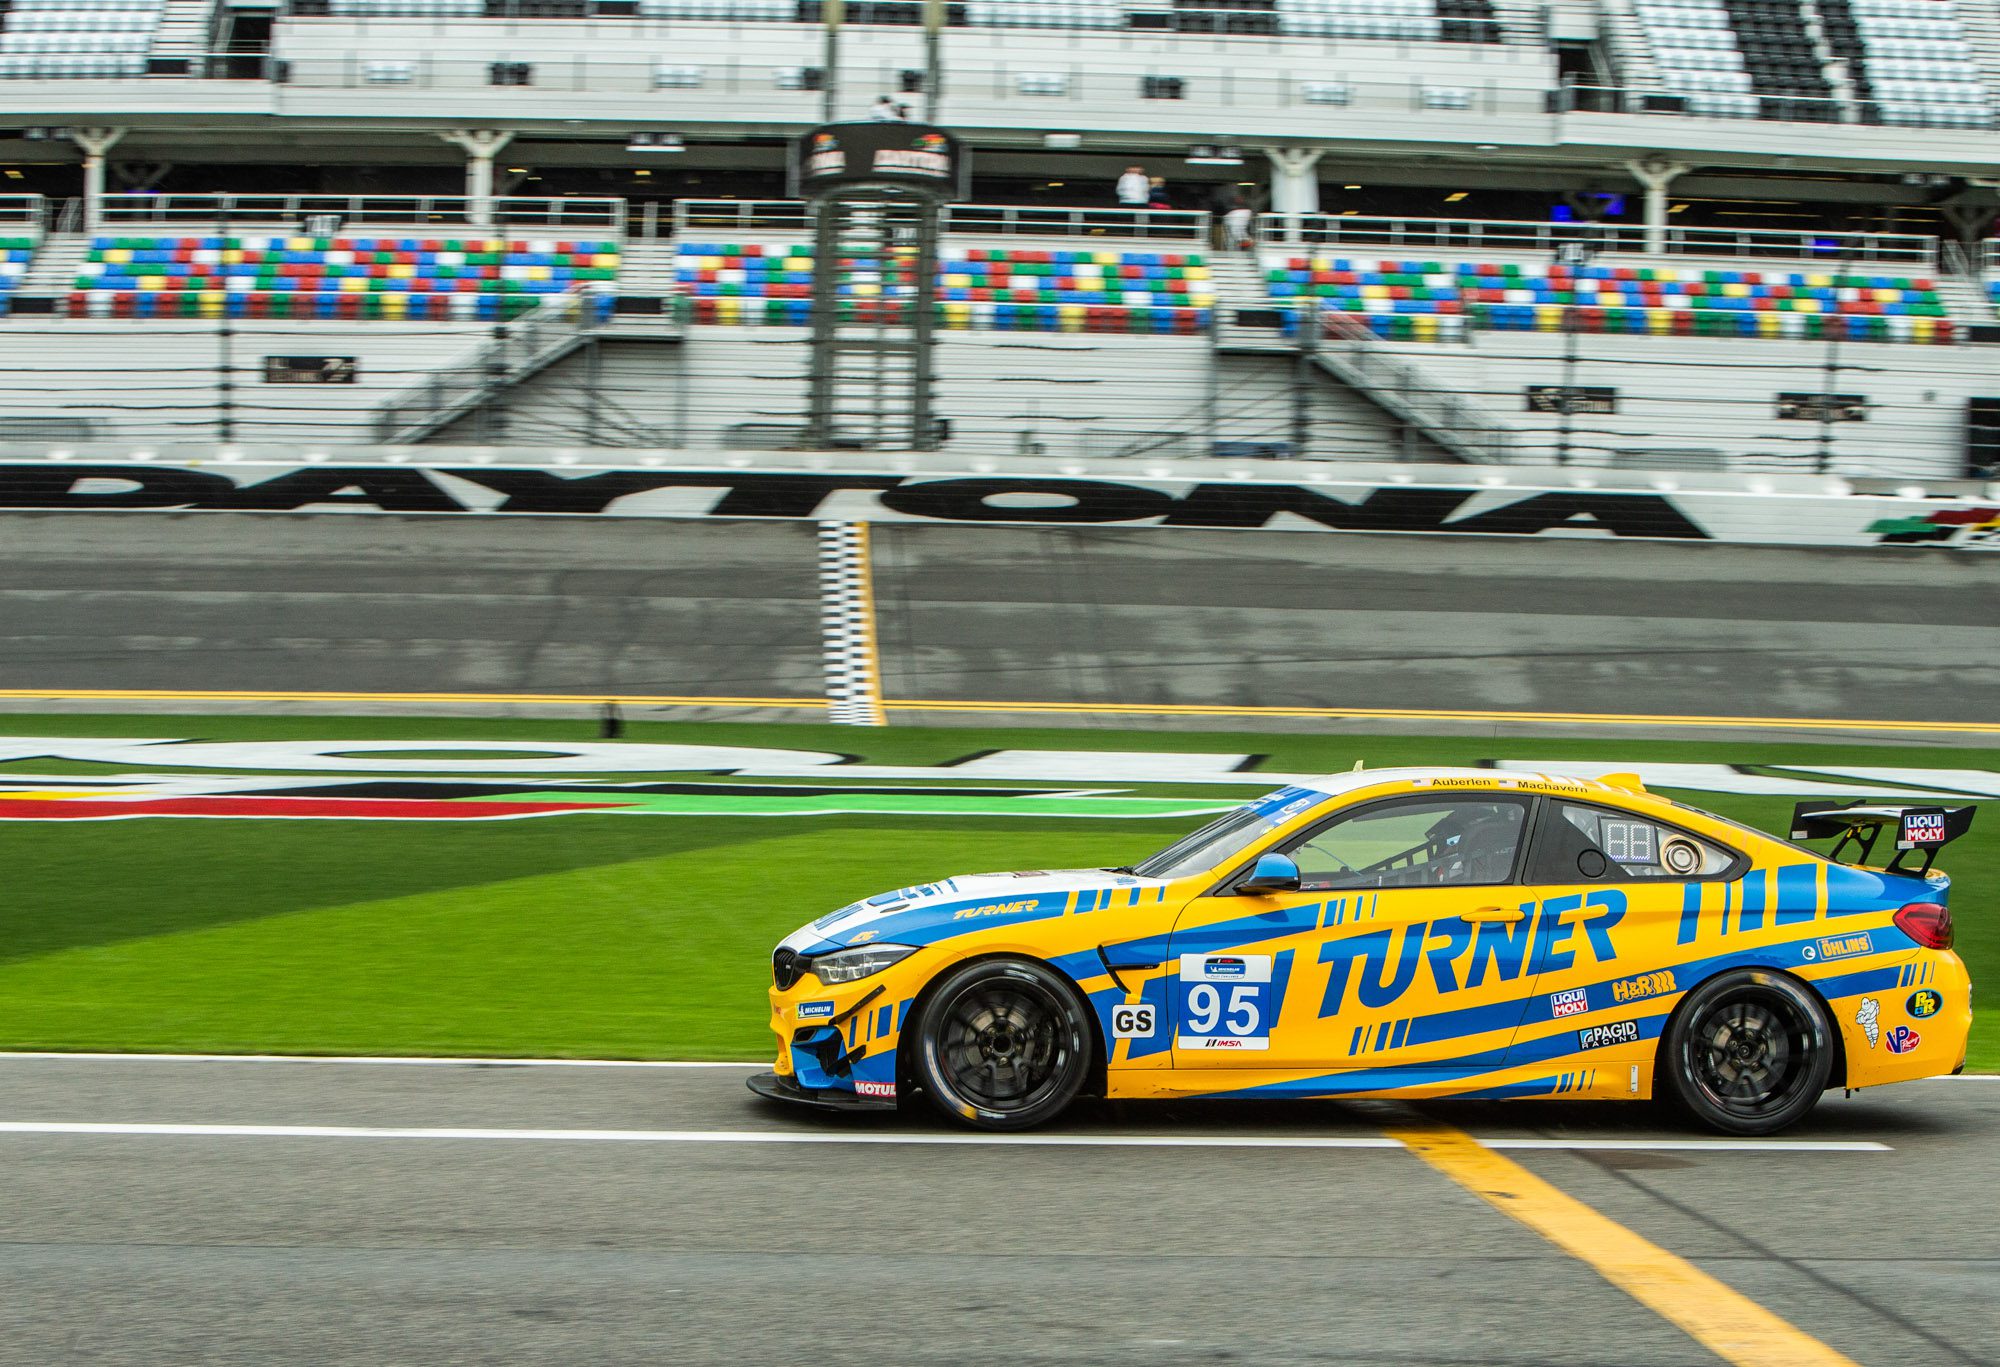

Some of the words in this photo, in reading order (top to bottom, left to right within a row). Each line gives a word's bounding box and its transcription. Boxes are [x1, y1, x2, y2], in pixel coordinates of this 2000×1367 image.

[0, 465, 1714, 540] DAYTONA
[1432, 778, 1491, 786] Auberlen
[1518, 781, 1588, 793] Machavern
[1907, 816, 1942, 828] LIQUI
[1907, 828, 1944, 841] MOLY
[953, 899, 1039, 920] TURNER
[1317, 889, 1628, 1019] TURNER
[1821, 936, 1869, 957] ÖHLINS
[1552, 990, 1585, 1005] LIQUI
[804, 1005, 831, 1014] MICHELIN
[1188, 984, 1260, 1036] 95
[1554, 1001, 1587, 1016] MOLY
[1115, 1010, 1152, 1032] GS
[1593, 1021, 1637, 1041] PAGID
[1581, 1034, 1638, 1049] RACING
[1886, 1026, 1909, 1053] VP
[855, 1082, 897, 1095] MOTUL
